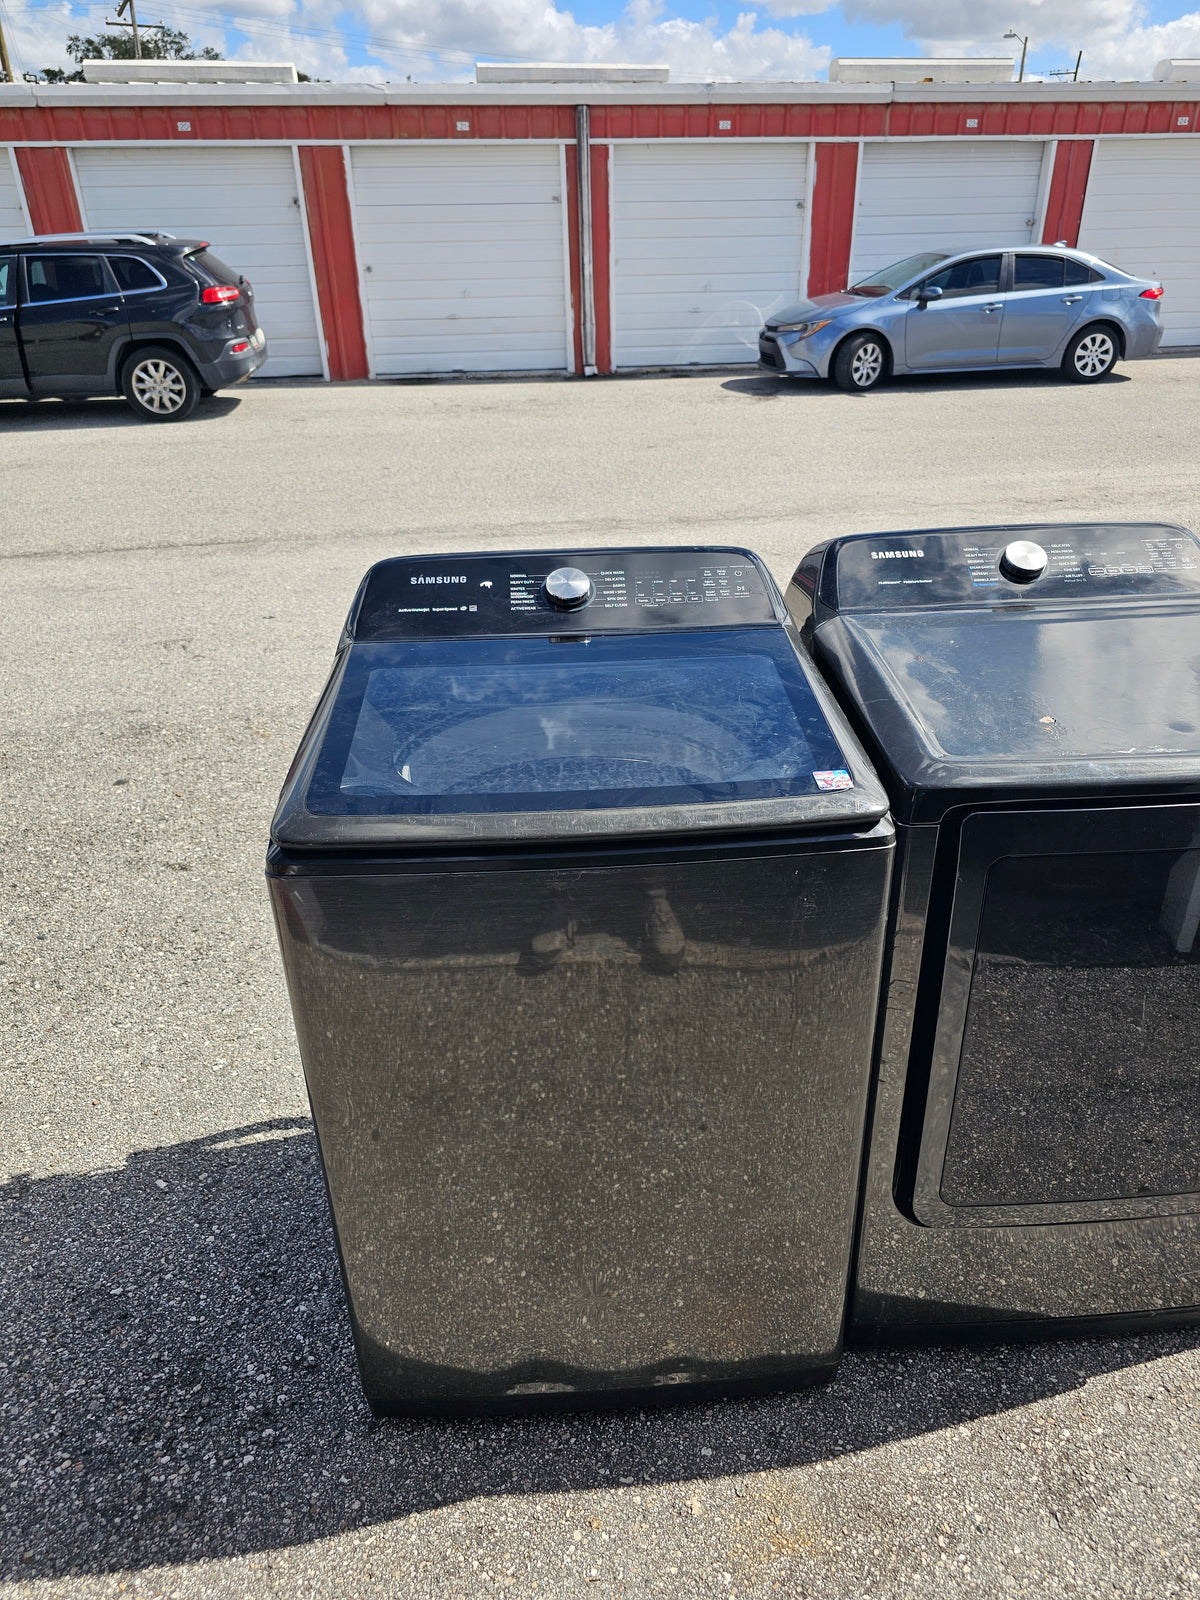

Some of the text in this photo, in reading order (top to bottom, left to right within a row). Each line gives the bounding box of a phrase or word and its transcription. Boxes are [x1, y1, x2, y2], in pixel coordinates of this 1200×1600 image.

[179, 122, 190, 131] 20
[871, 550, 924, 559] SAMSUNG
[410, 576, 467, 584] SAMSUNG
